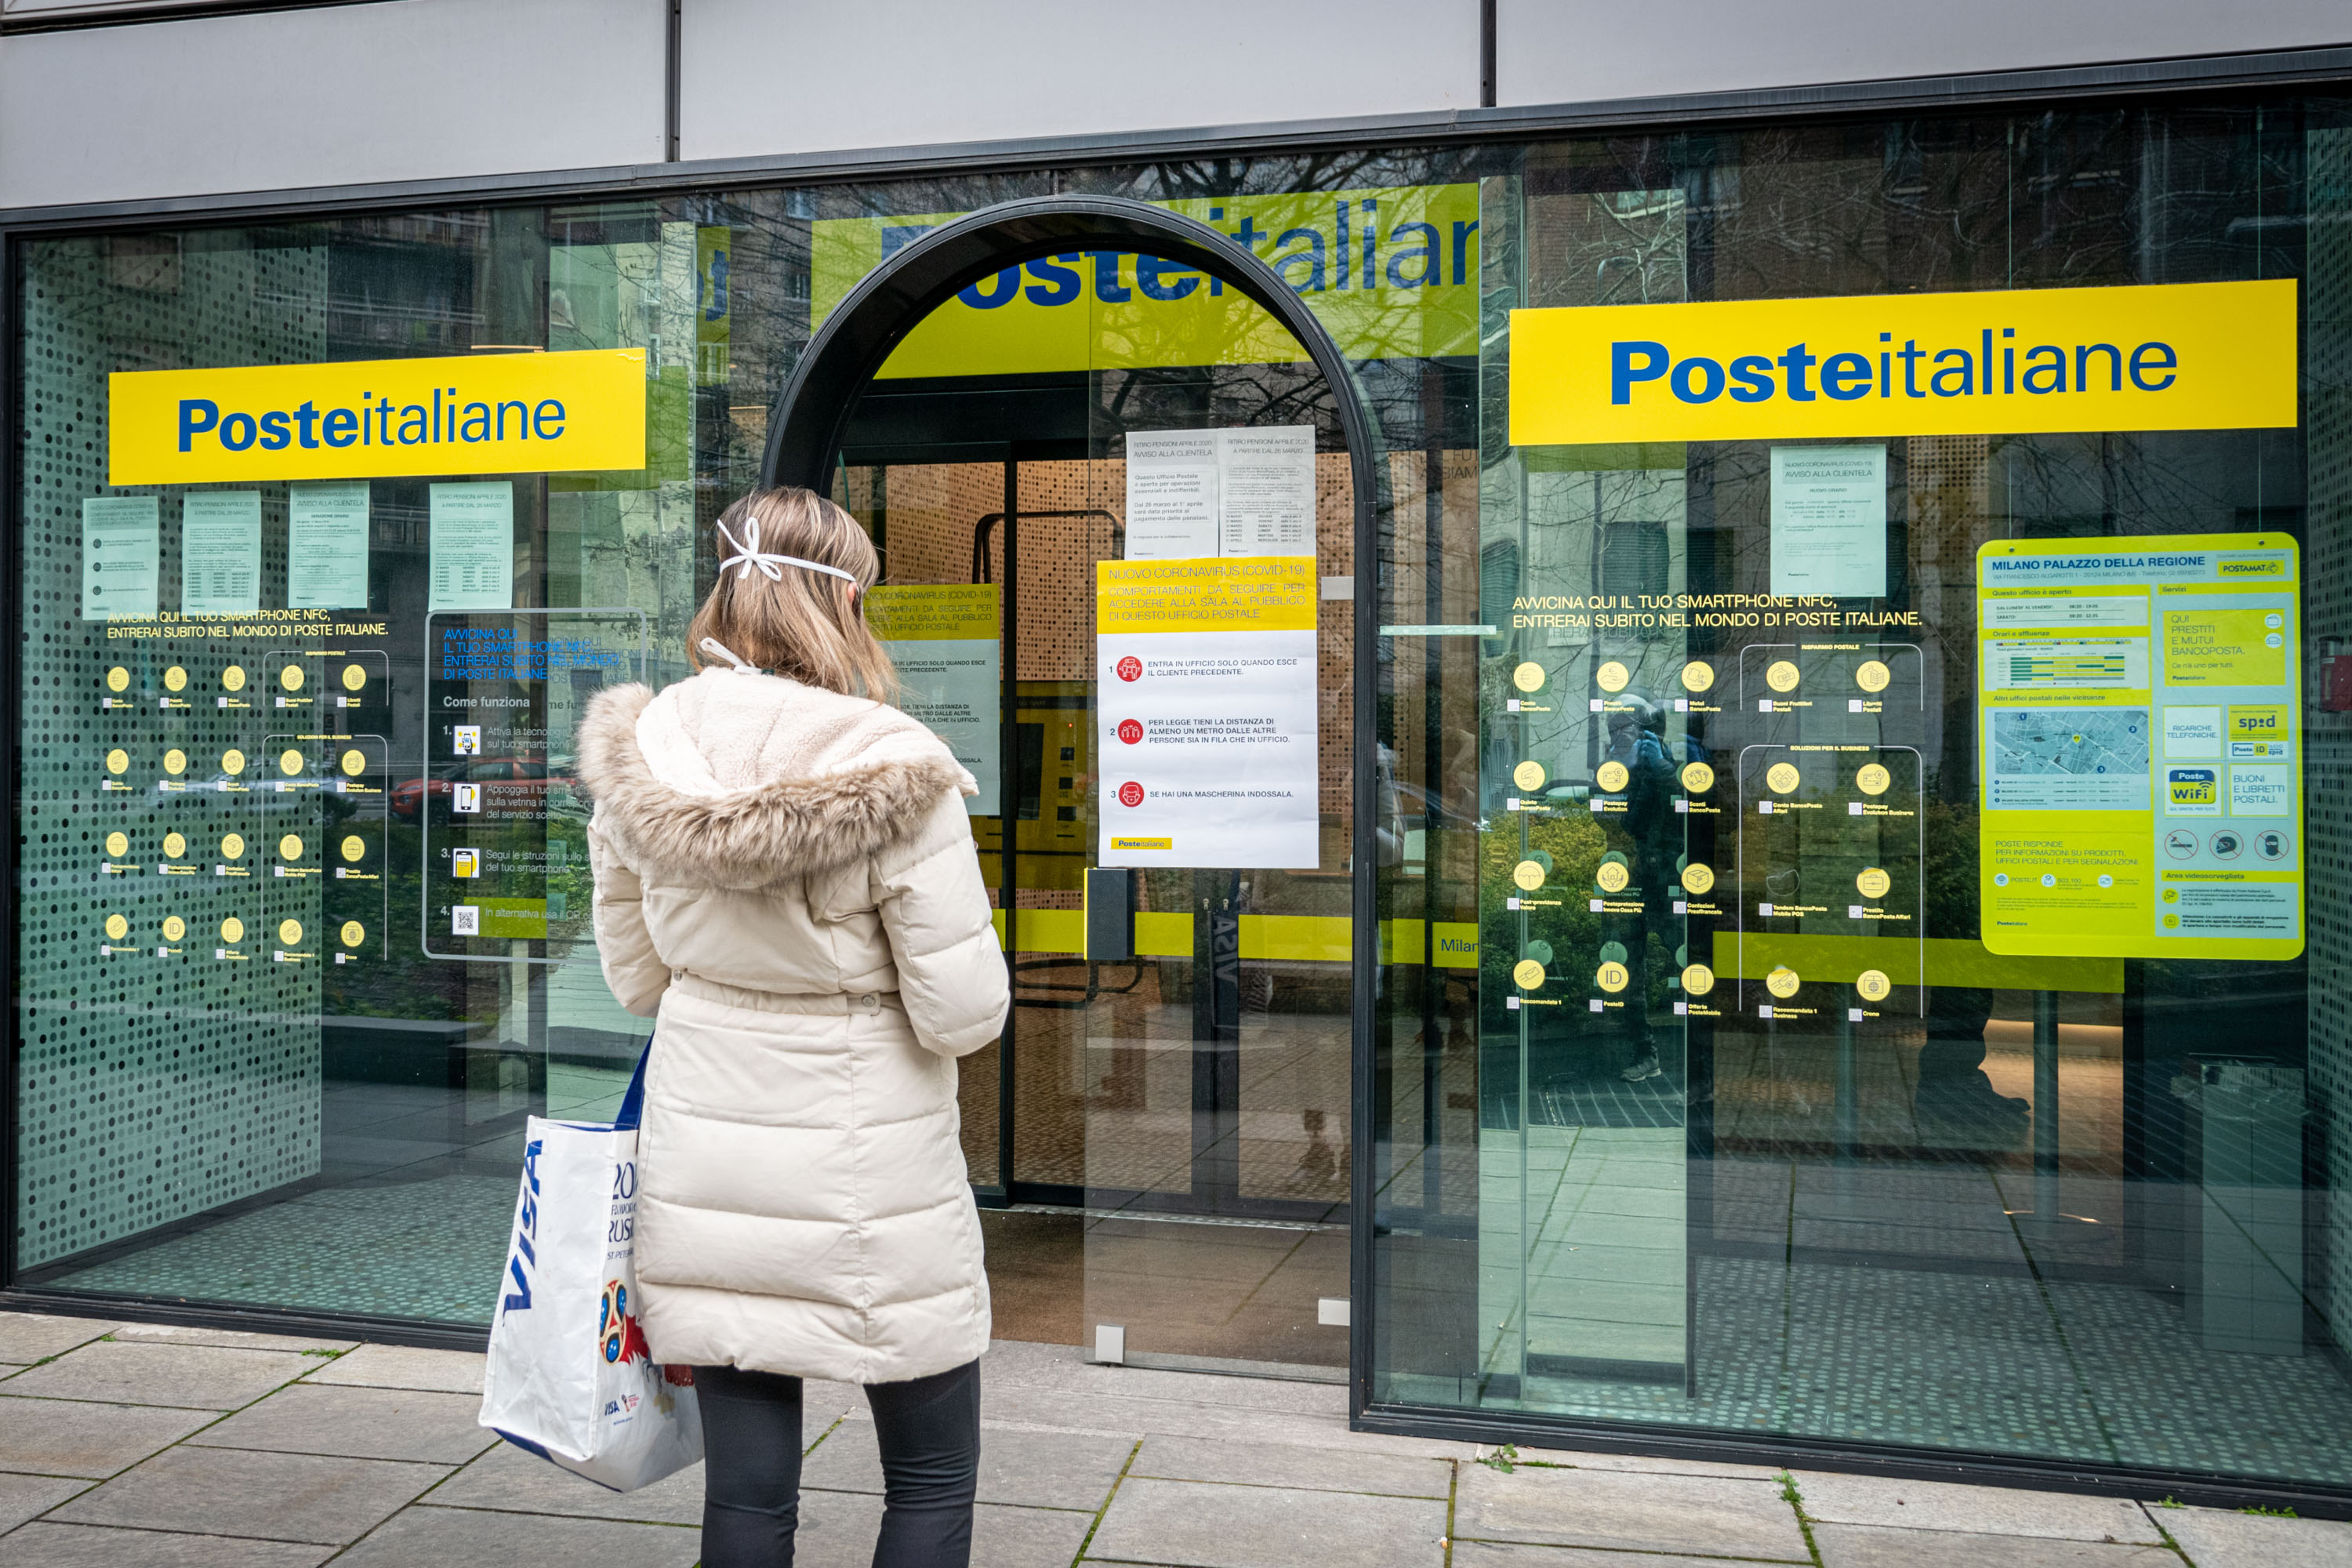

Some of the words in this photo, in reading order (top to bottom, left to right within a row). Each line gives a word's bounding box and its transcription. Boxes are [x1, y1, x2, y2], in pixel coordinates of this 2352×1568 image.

[1612, 328, 2176, 405] Posteitaliane
[180, 388, 564, 452] Posteitaliane
[1992, 561, 2039, 570] MILANO
[2044, 559, 2100, 569] PALAZZO
[2104, 558, 2144, 568] DELLA
[2148, 557, 2205, 567] REGIONE
[1109, 568, 1151, 579] NUOVO
[1154, 566, 1240, 578] CORONAVIRUS
[1243, 564, 1305, 577] (COVID-19)
[1109, 586, 1200, 596] COMPORTAMENTI
[1208, 585, 1222, 595] DA
[1229, 583, 1276, 593] SEGUIRE
[1283, 583, 1305, 592] PER
[1109, 599, 1165, 608] ACCEDERE
[1170, 597, 1196, 607] ALLA
[1200, 597, 1228, 607] SALA
[1232, 597, 1245, 606] AL
[1250, 596, 1305, 605] PUBBLICO
[1512, 597, 1584, 609] AVVICINA
[1588, 596, 1616, 609] QUI
[1621, 596, 1634, 608] IL
[1638, 595, 1672, 608] TUO
[1677, 594, 1793, 608] SMARTPHONE
[1798, 593, 1837, 609] NFC,
[107, 612, 155, 623] AVVICINA
[159, 612, 179, 622] QUI
[181, 612, 191, 622] IL
[194, 611, 218, 622] TUO
[220, 609, 300, 622] SMARTPHONE
[303, 609, 330, 622] NFC,
[1122, 611, 1166, 620] QUESTO
[1168, 610, 1209, 619] UFFICIO
[1212, 608, 1260, 619] POSTALE
[1513, 615, 1590, 627] ENTRERAI
[1595, 614, 1653, 627] SUBITO
[1659, 613, 1691, 627] NEL
[1695, 613, 1759, 626] MONDO
[1764, 612, 1780, 626] DI
[1785, 612, 1841, 626] POSTE
[1846, 612, 1922, 626] ITALIANE.
[107, 627, 161, 639] ENTRERAI
[164, 626, 205, 638] SUBITO
[208, 626, 230, 637] NEL
[232, 626, 277, 637] MONDO
[281, 626, 291, 636] DI
[295, 625, 332, 636] POSTE
[336, 623, 389, 635] ITALIANE.
[444, 629, 495, 640] AVVICINA
[498, 628, 517, 639] QUI
[444, 642, 453, 653] IL
[456, 642, 480, 653] TUO
[483, 641, 563, 652] SMARTPHONE
[2172, 647, 2245, 655] BANCOPOSTA.
[444, 655, 499, 666] ENTRERAI
[503, 655, 544, 666] SUBITO
[444, 669, 455, 680] DI
[458, 669, 495, 680] POSTE
[444, 696, 477, 707] Come
[481, 696, 530, 706] funziona
[2239, 715, 2275, 731] spid
[443, 725, 452, 735] 1.
[487, 727, 511, 735] Attiva
[514, 727, 521, 735] la
[442, 783, 451, 793] 2.
[487, 785, 528, 796] Appoggia
[2173, 789, 2207, 799] WiFi
[487, 798, 506, 807] sulla
[508, 798, 536, 807] vetrina
[539, 798, 546, 807] in
[487, 810, 499, 818] del
[502, 810, 533, 819] servizio
[441, 848, 451, 858] 3.
[485, 850, 510, 860] Segui
[441, 906, 449, 916] 4.
[485, 908, 493, 916] In
[495, 909, 539, 919] alternativa
[1606, 970, 1622, 984] ID
[503, 1139, 543, 1327] VISA
